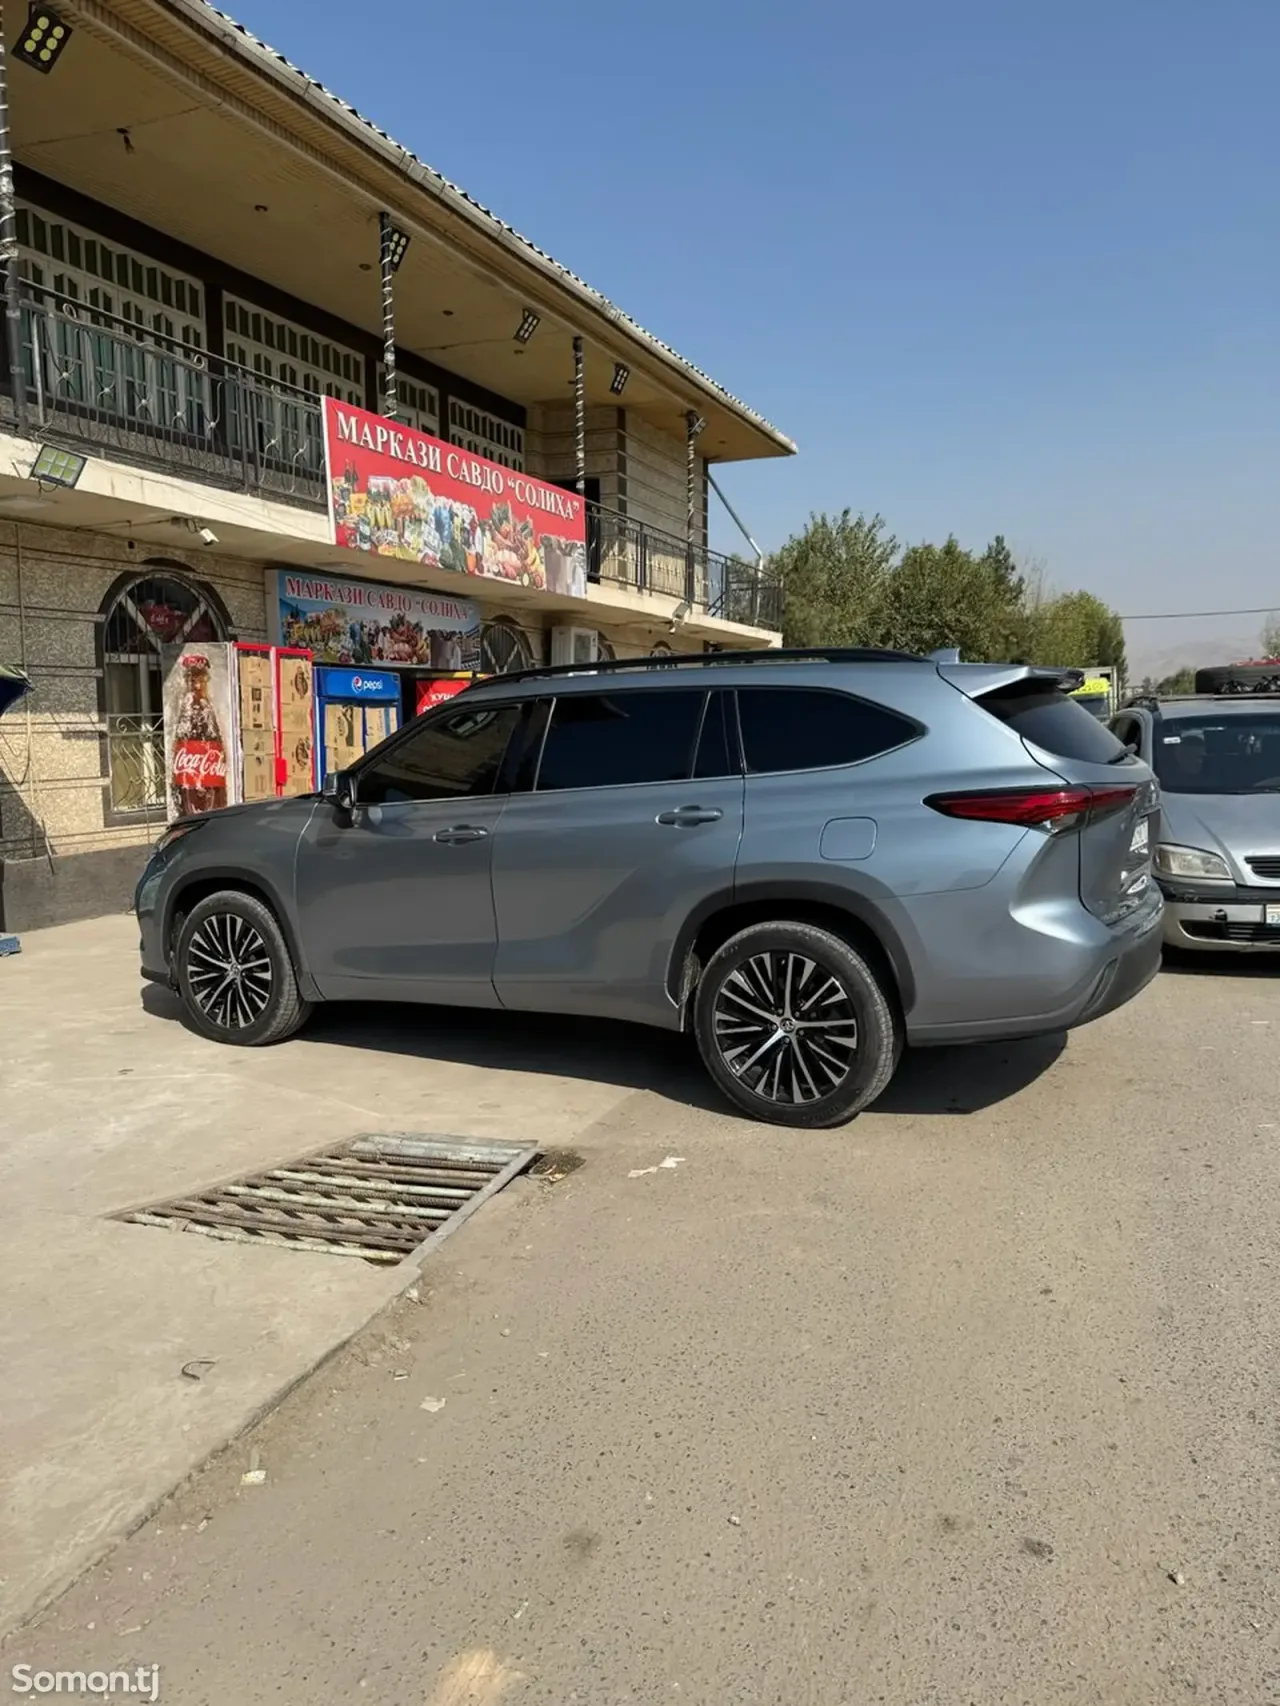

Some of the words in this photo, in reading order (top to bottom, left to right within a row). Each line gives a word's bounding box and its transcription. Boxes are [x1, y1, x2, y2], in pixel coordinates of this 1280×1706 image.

[336, 411, 441, 473] МАРКАЗИ
[446, 453, 504, 495] САВДО
[285, 575, 363, 606] МАРКАЗИ
[367, 590, 412, 613] САВДО
[363, 679, 383, 691] pepsi
[174, 747, 227, 777] Coca-Cola
